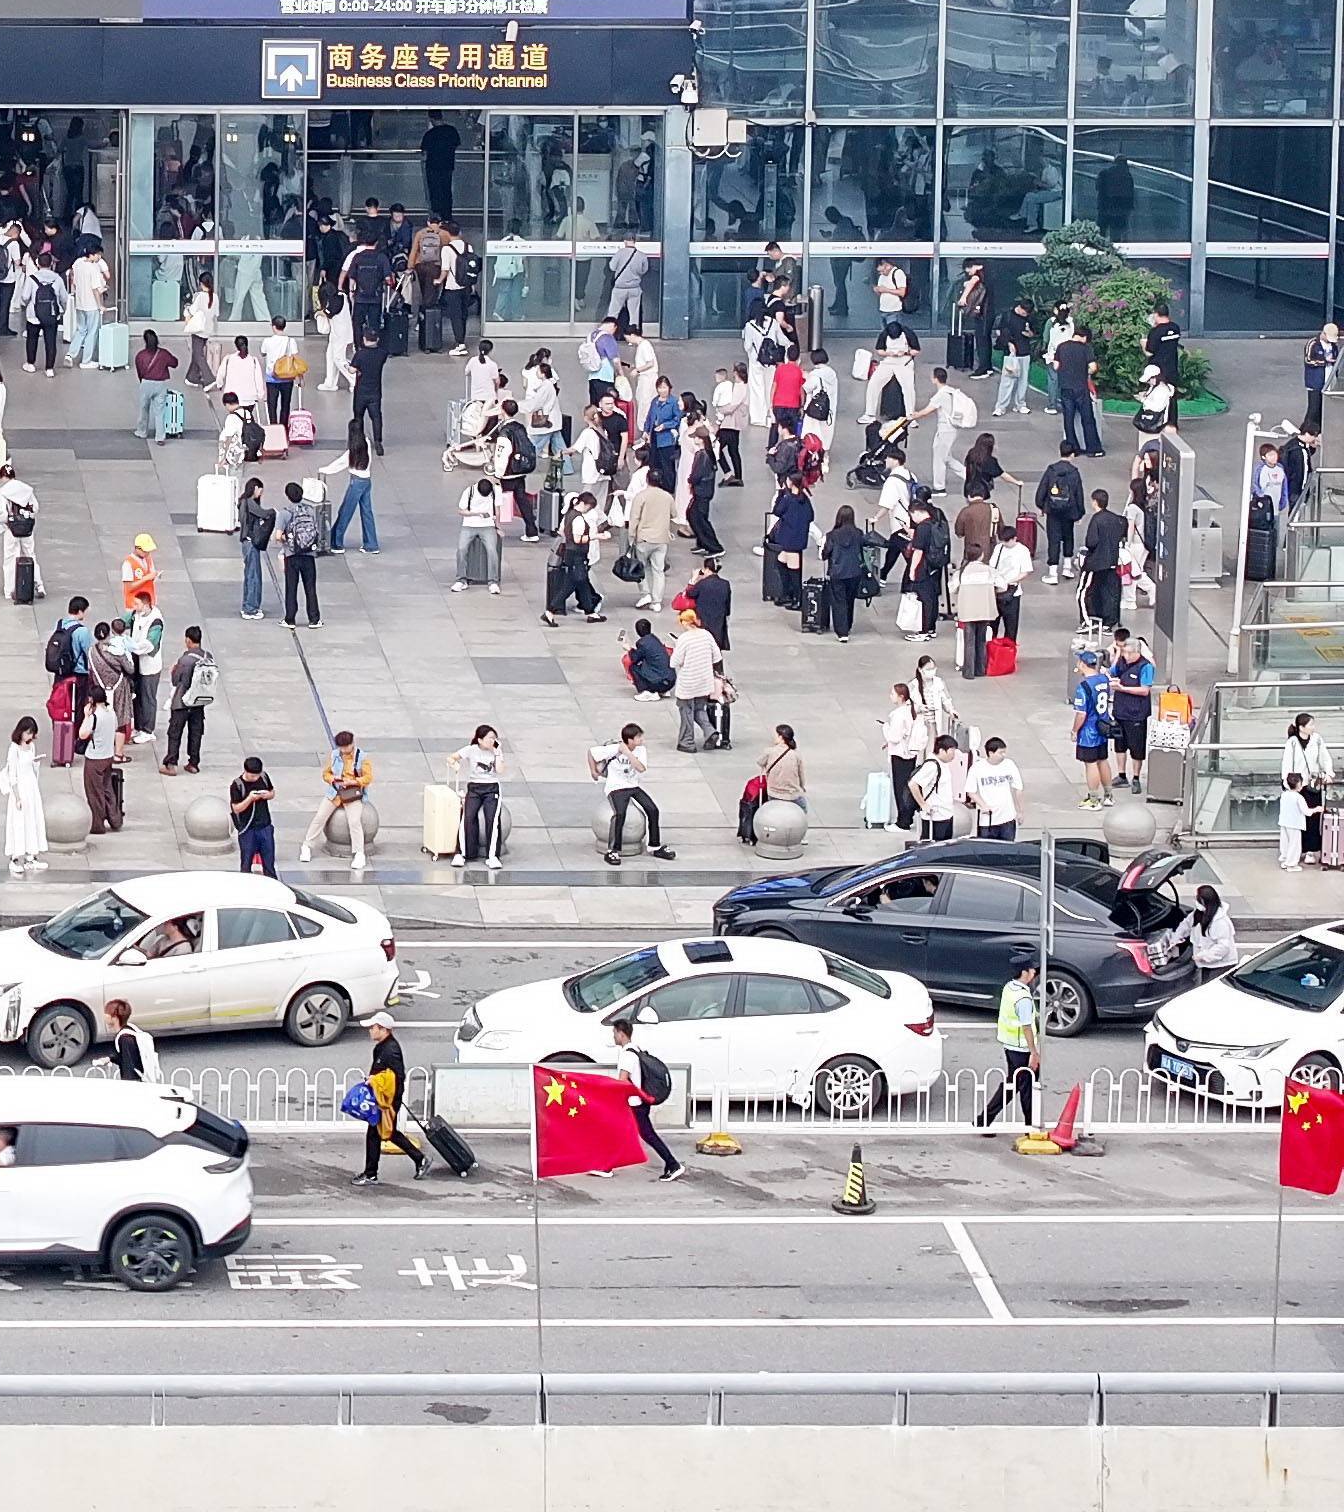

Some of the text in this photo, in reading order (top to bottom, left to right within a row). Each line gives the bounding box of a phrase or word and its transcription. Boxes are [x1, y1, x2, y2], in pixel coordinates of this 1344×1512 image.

[338, 0, 412, 12] 0:00-24:00
[327, 43, 548, 71] 商务座专用通道
[326, 73, 548, 91] Business Class Priority channel
[1096, 691, 1109, 714] 8
